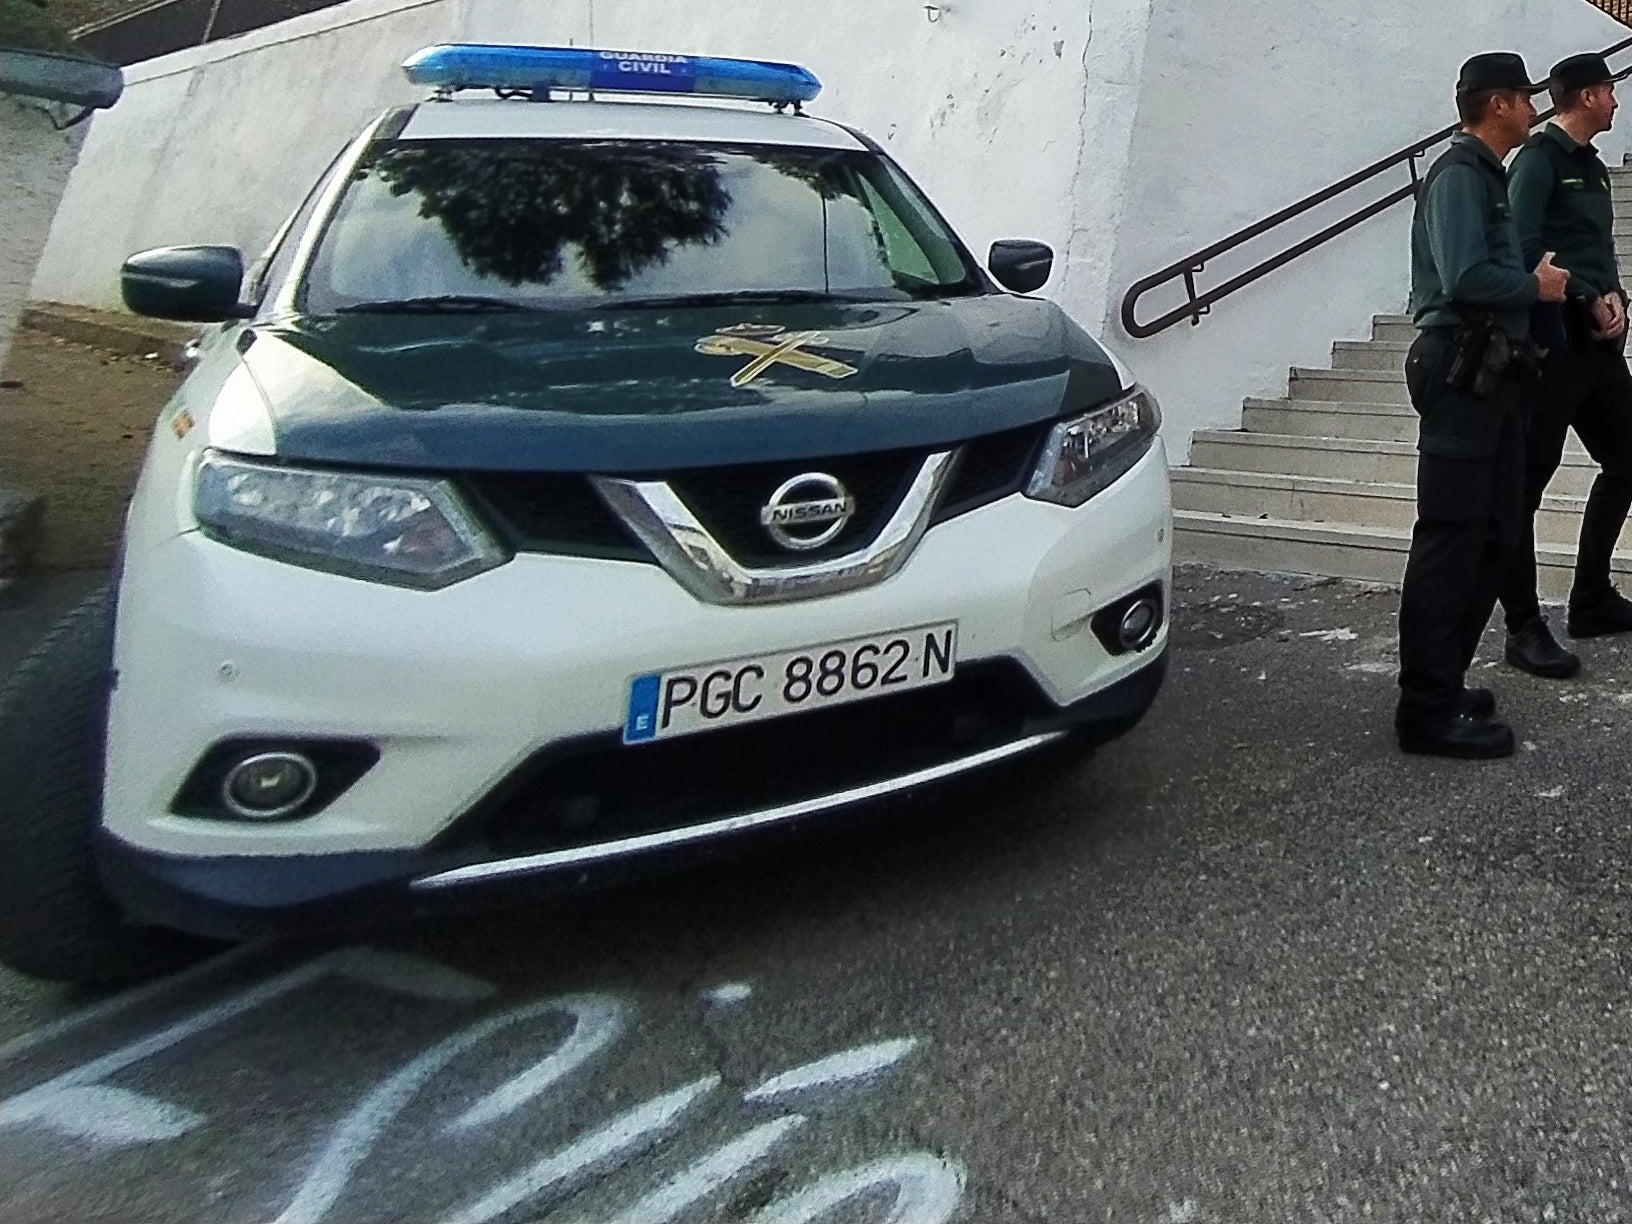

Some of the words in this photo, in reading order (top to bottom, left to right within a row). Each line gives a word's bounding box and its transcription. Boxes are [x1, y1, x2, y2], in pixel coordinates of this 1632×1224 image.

[600, 51, 688, 64] GUARDIA
[618, 61, 671, 74] CIVIL
[772, 501, 848, 522] NISSAN
[660, 664, 765, 729] PGC
[782, 638, 910, 704] 8862
[922, 628, 953, 678] N
[634, 714, 649, 731] E
